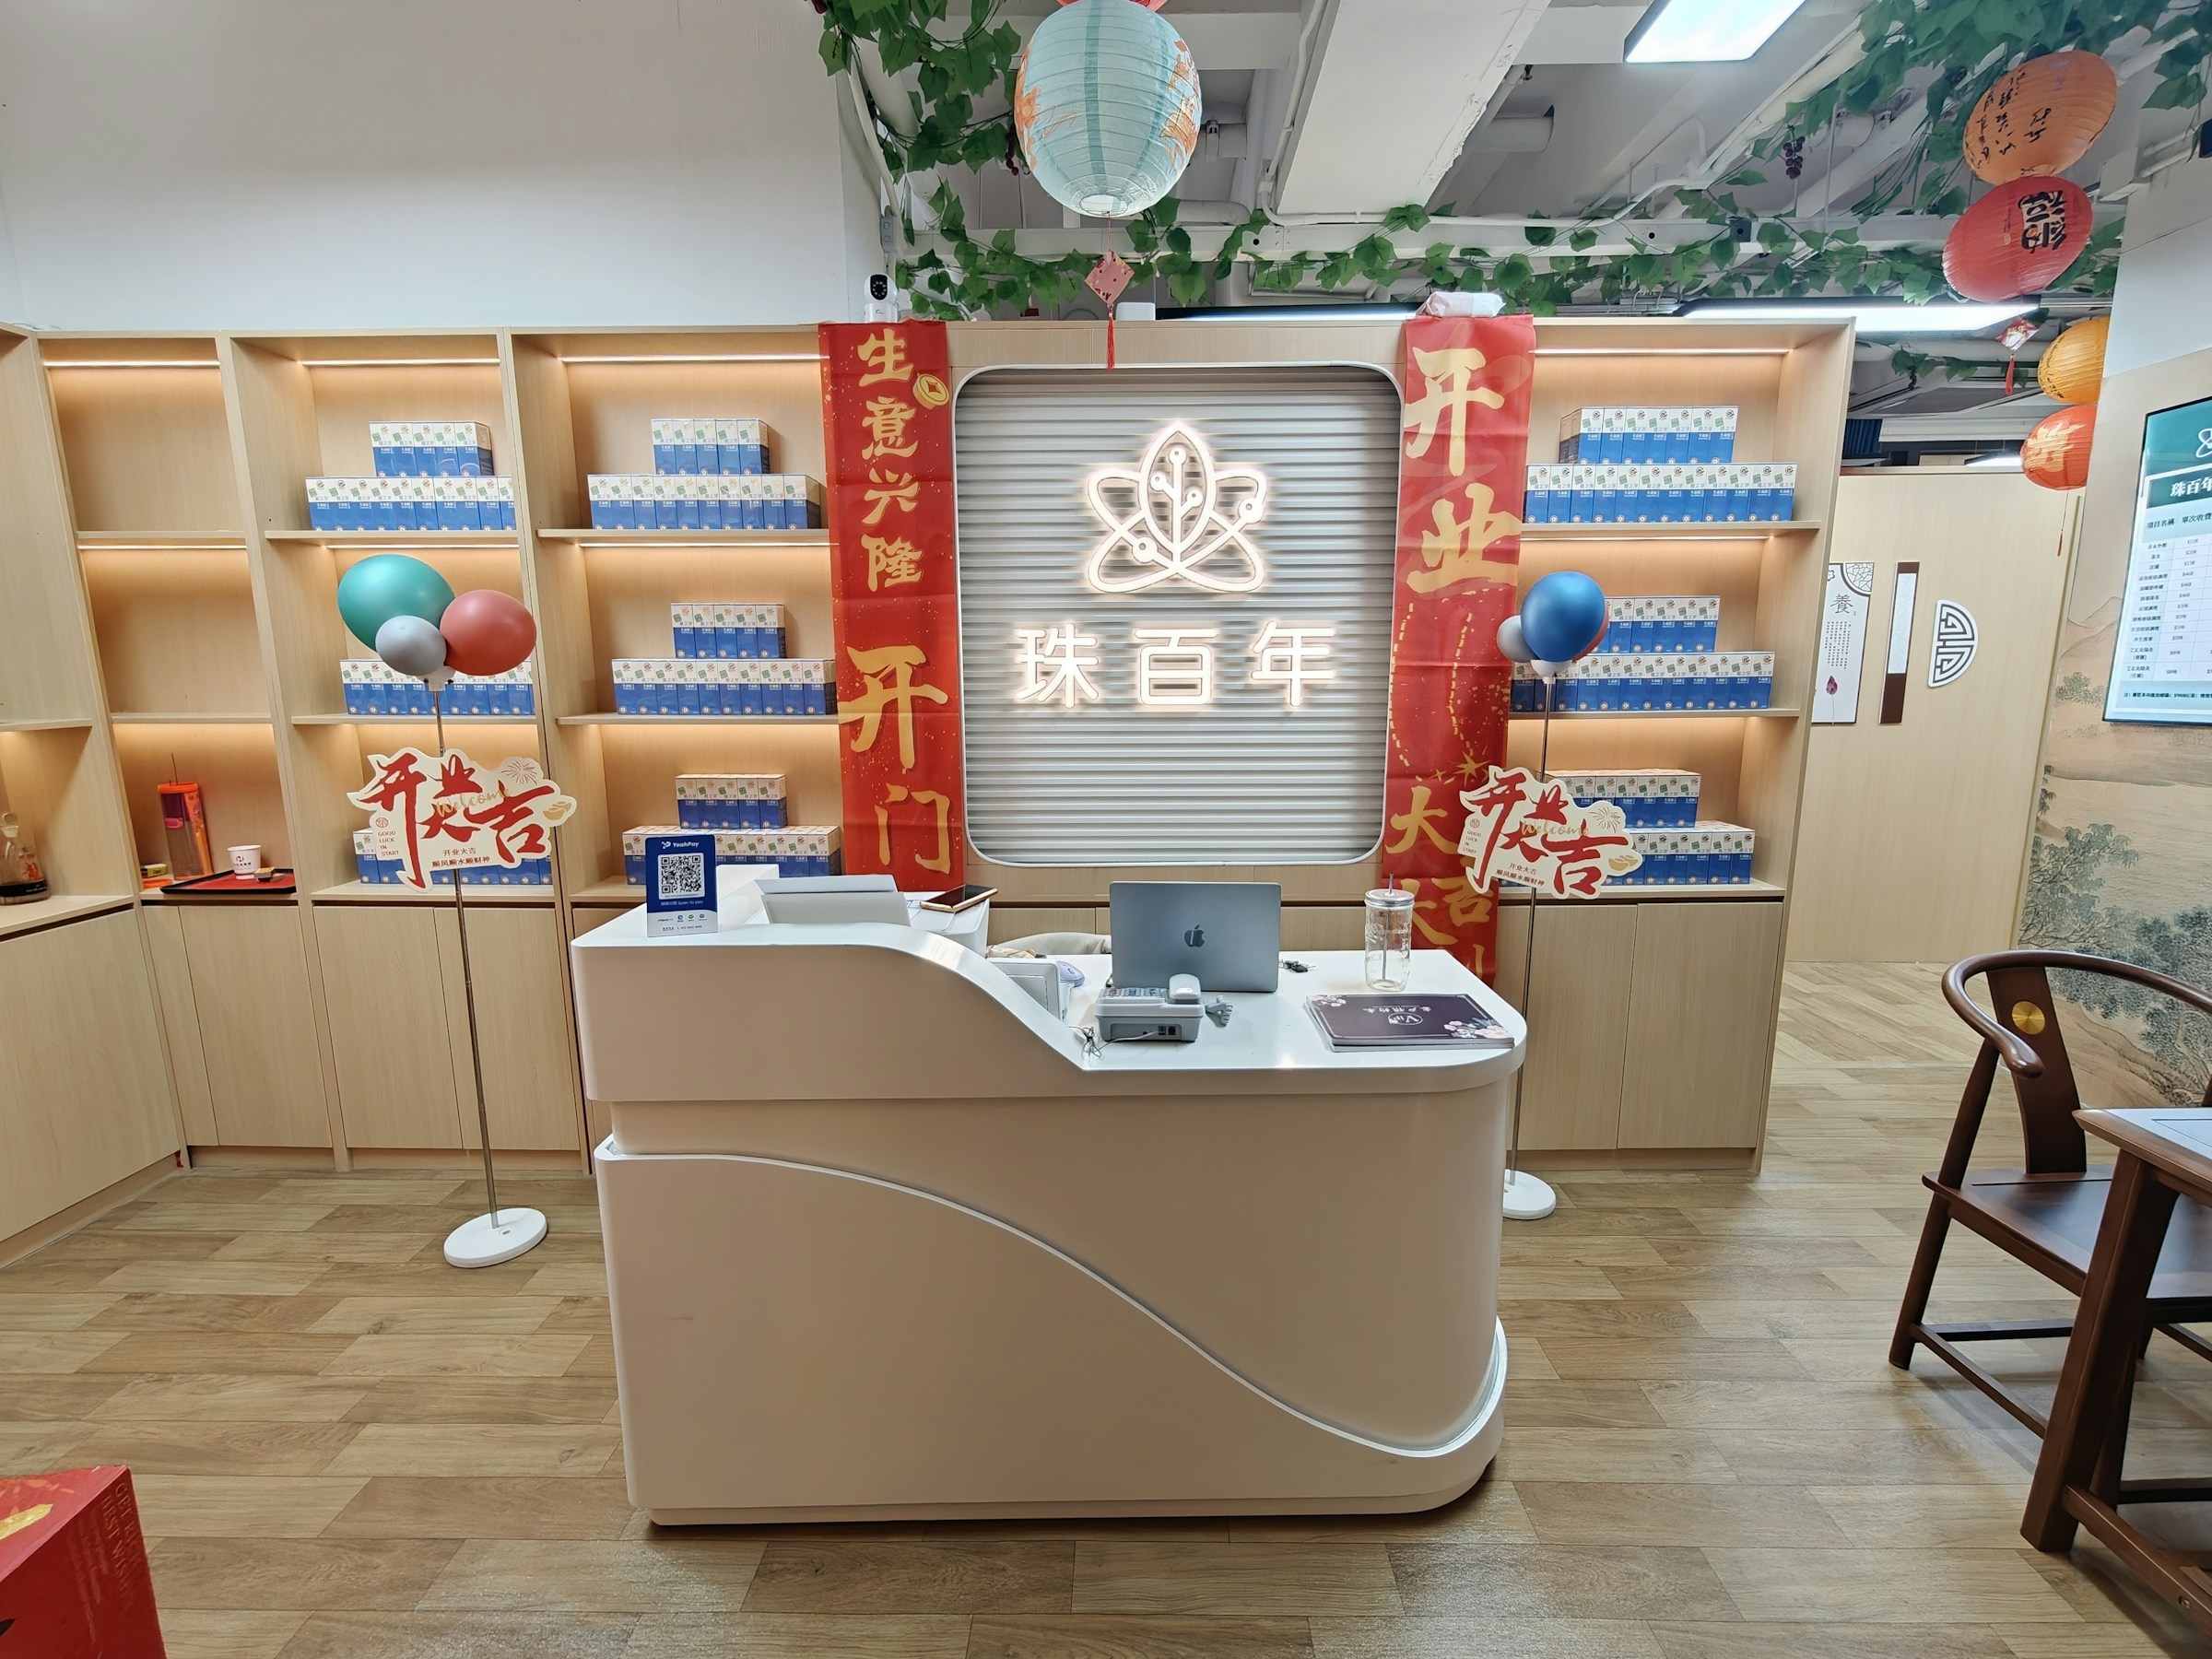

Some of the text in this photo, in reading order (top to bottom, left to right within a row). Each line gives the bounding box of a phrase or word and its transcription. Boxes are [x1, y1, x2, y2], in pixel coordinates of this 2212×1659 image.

[857, 334, 924, 593] 生意兴隆
[1405, 347, 1522, 594] 开业
[2147, 518, 2175, 529] 項目名稱
[1830, 594, 1853, 614] 養
[1016, 620, 1336, 708] 珠百年
[838, 644, 950, 875] 开门
[435, 787, 513, 818] Welcome
[357, 752, 555, 889] 开业大吉
[1465, 771, 1629, 895] 开业大吉
[1521, 819, 1592, 838] Welcome
[431, 856, 490, 868] 顺风顺水顺财神
[442, 847, 477, 857] 开业大吉
[1496, 869, 1545, 886] 顺风顺水顺财神
[1509, 863, 1537, 876] 开业大吉
[114, 1482, 133, 1518] GET
[100, 1495, 120, 1540] BEST
